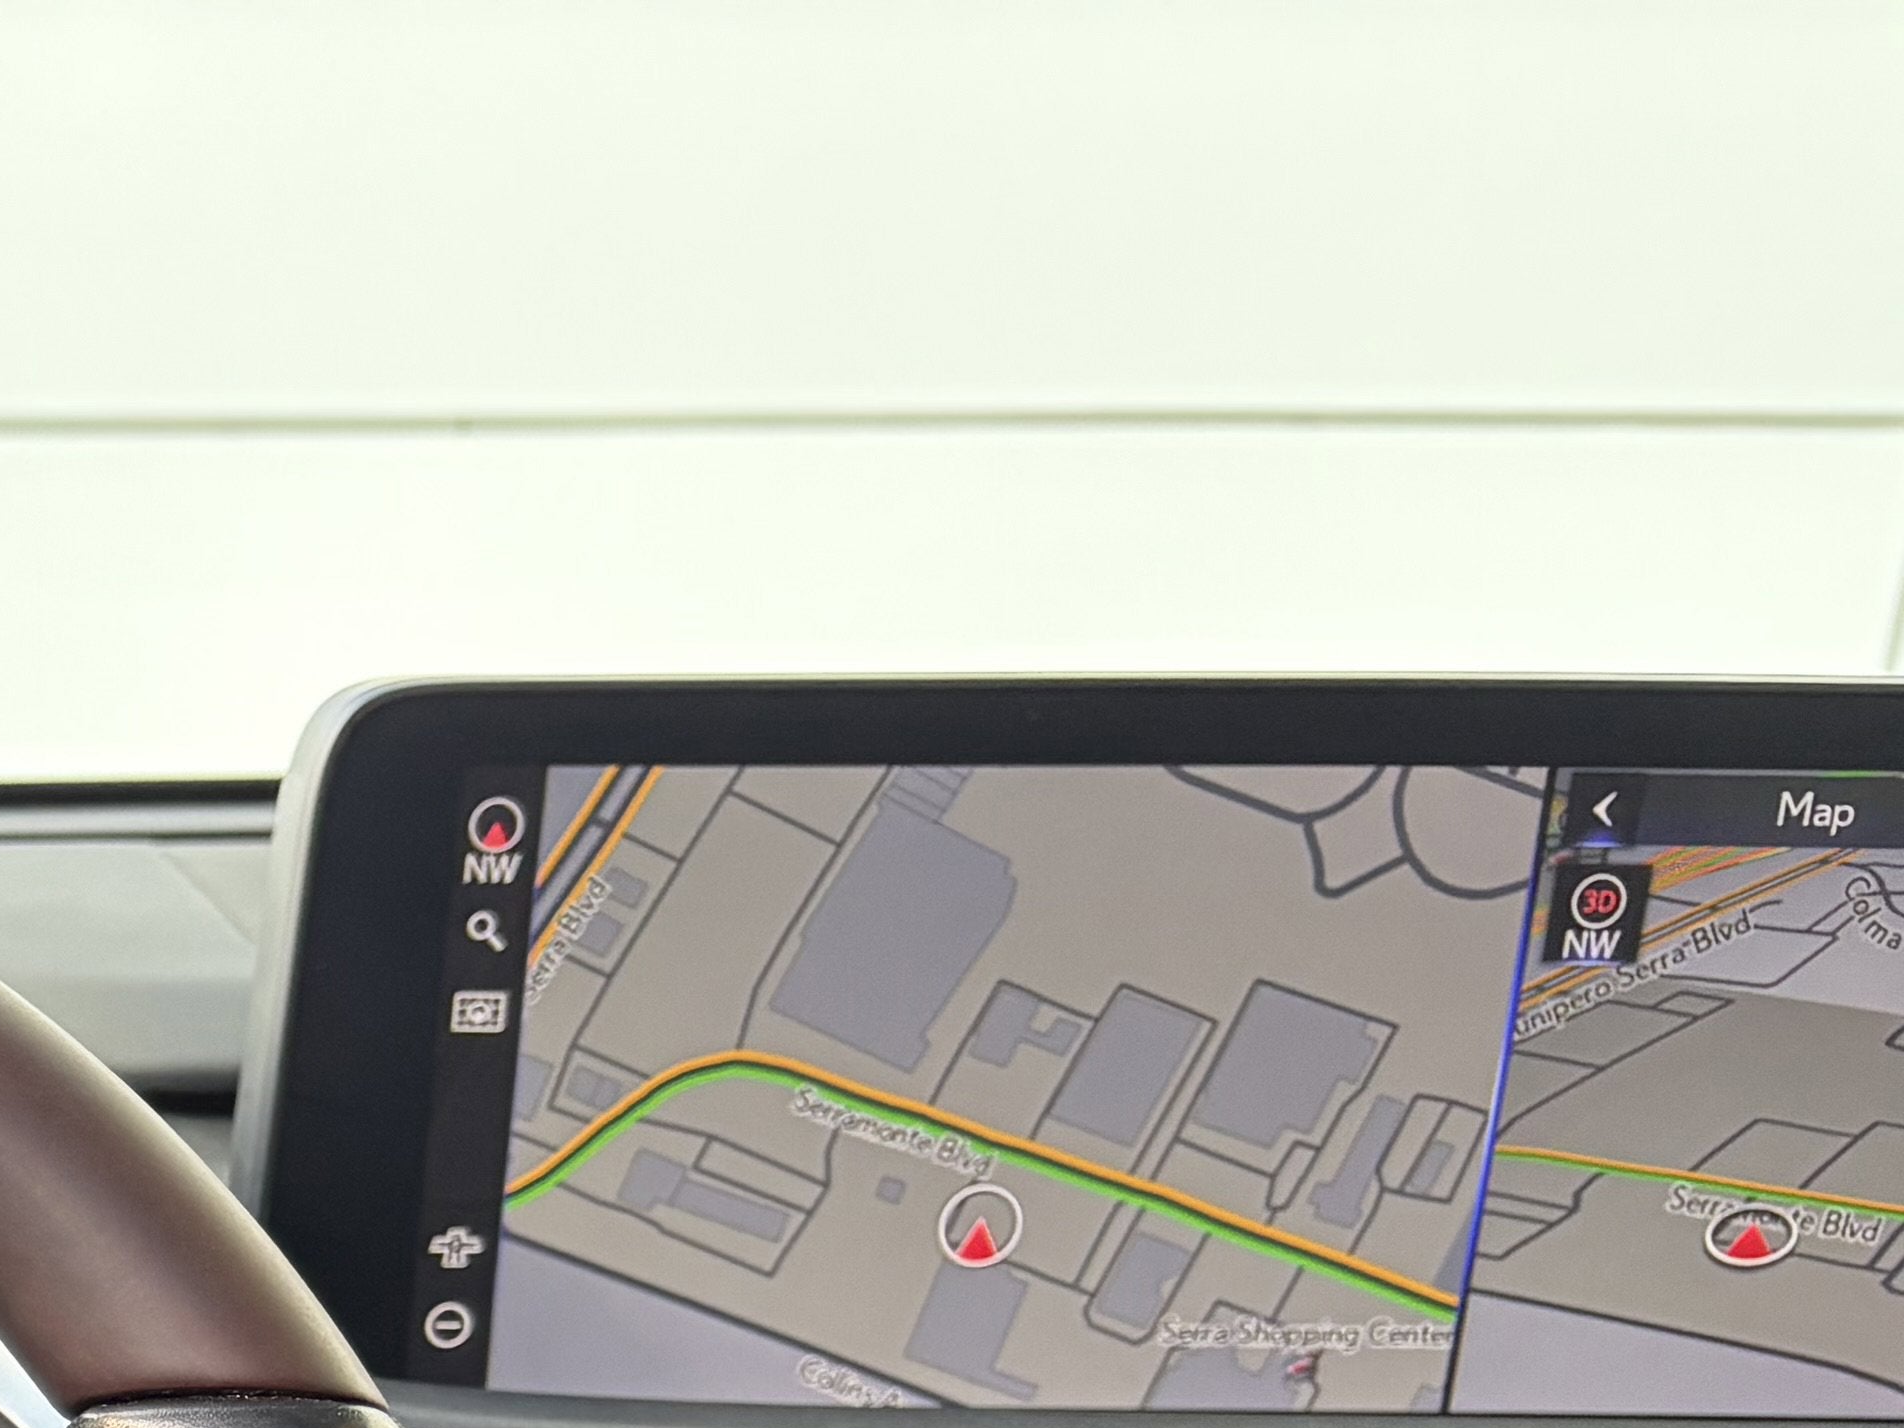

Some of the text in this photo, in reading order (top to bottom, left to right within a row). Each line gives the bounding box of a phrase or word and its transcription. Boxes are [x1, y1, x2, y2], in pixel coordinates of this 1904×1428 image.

[1776, 791, 1855, 836] Map
[463, 853, 523, 885] NW
[558, 875, 608, 937] Blvd
[1582, 890, 1617, 915] 3D
[1844, 876, 1903, 952] Colma
[1562, 930, 1622, 960] NW
[1515, 909, 1753, 1036] unipero Serra Blvd
[795, 1088, 991, 1176] Serramonte Blvd
[1821, 1210, 1882, 1242] Blvd
[1160, 1316, 1454, 1351] Serra Shopping Center
